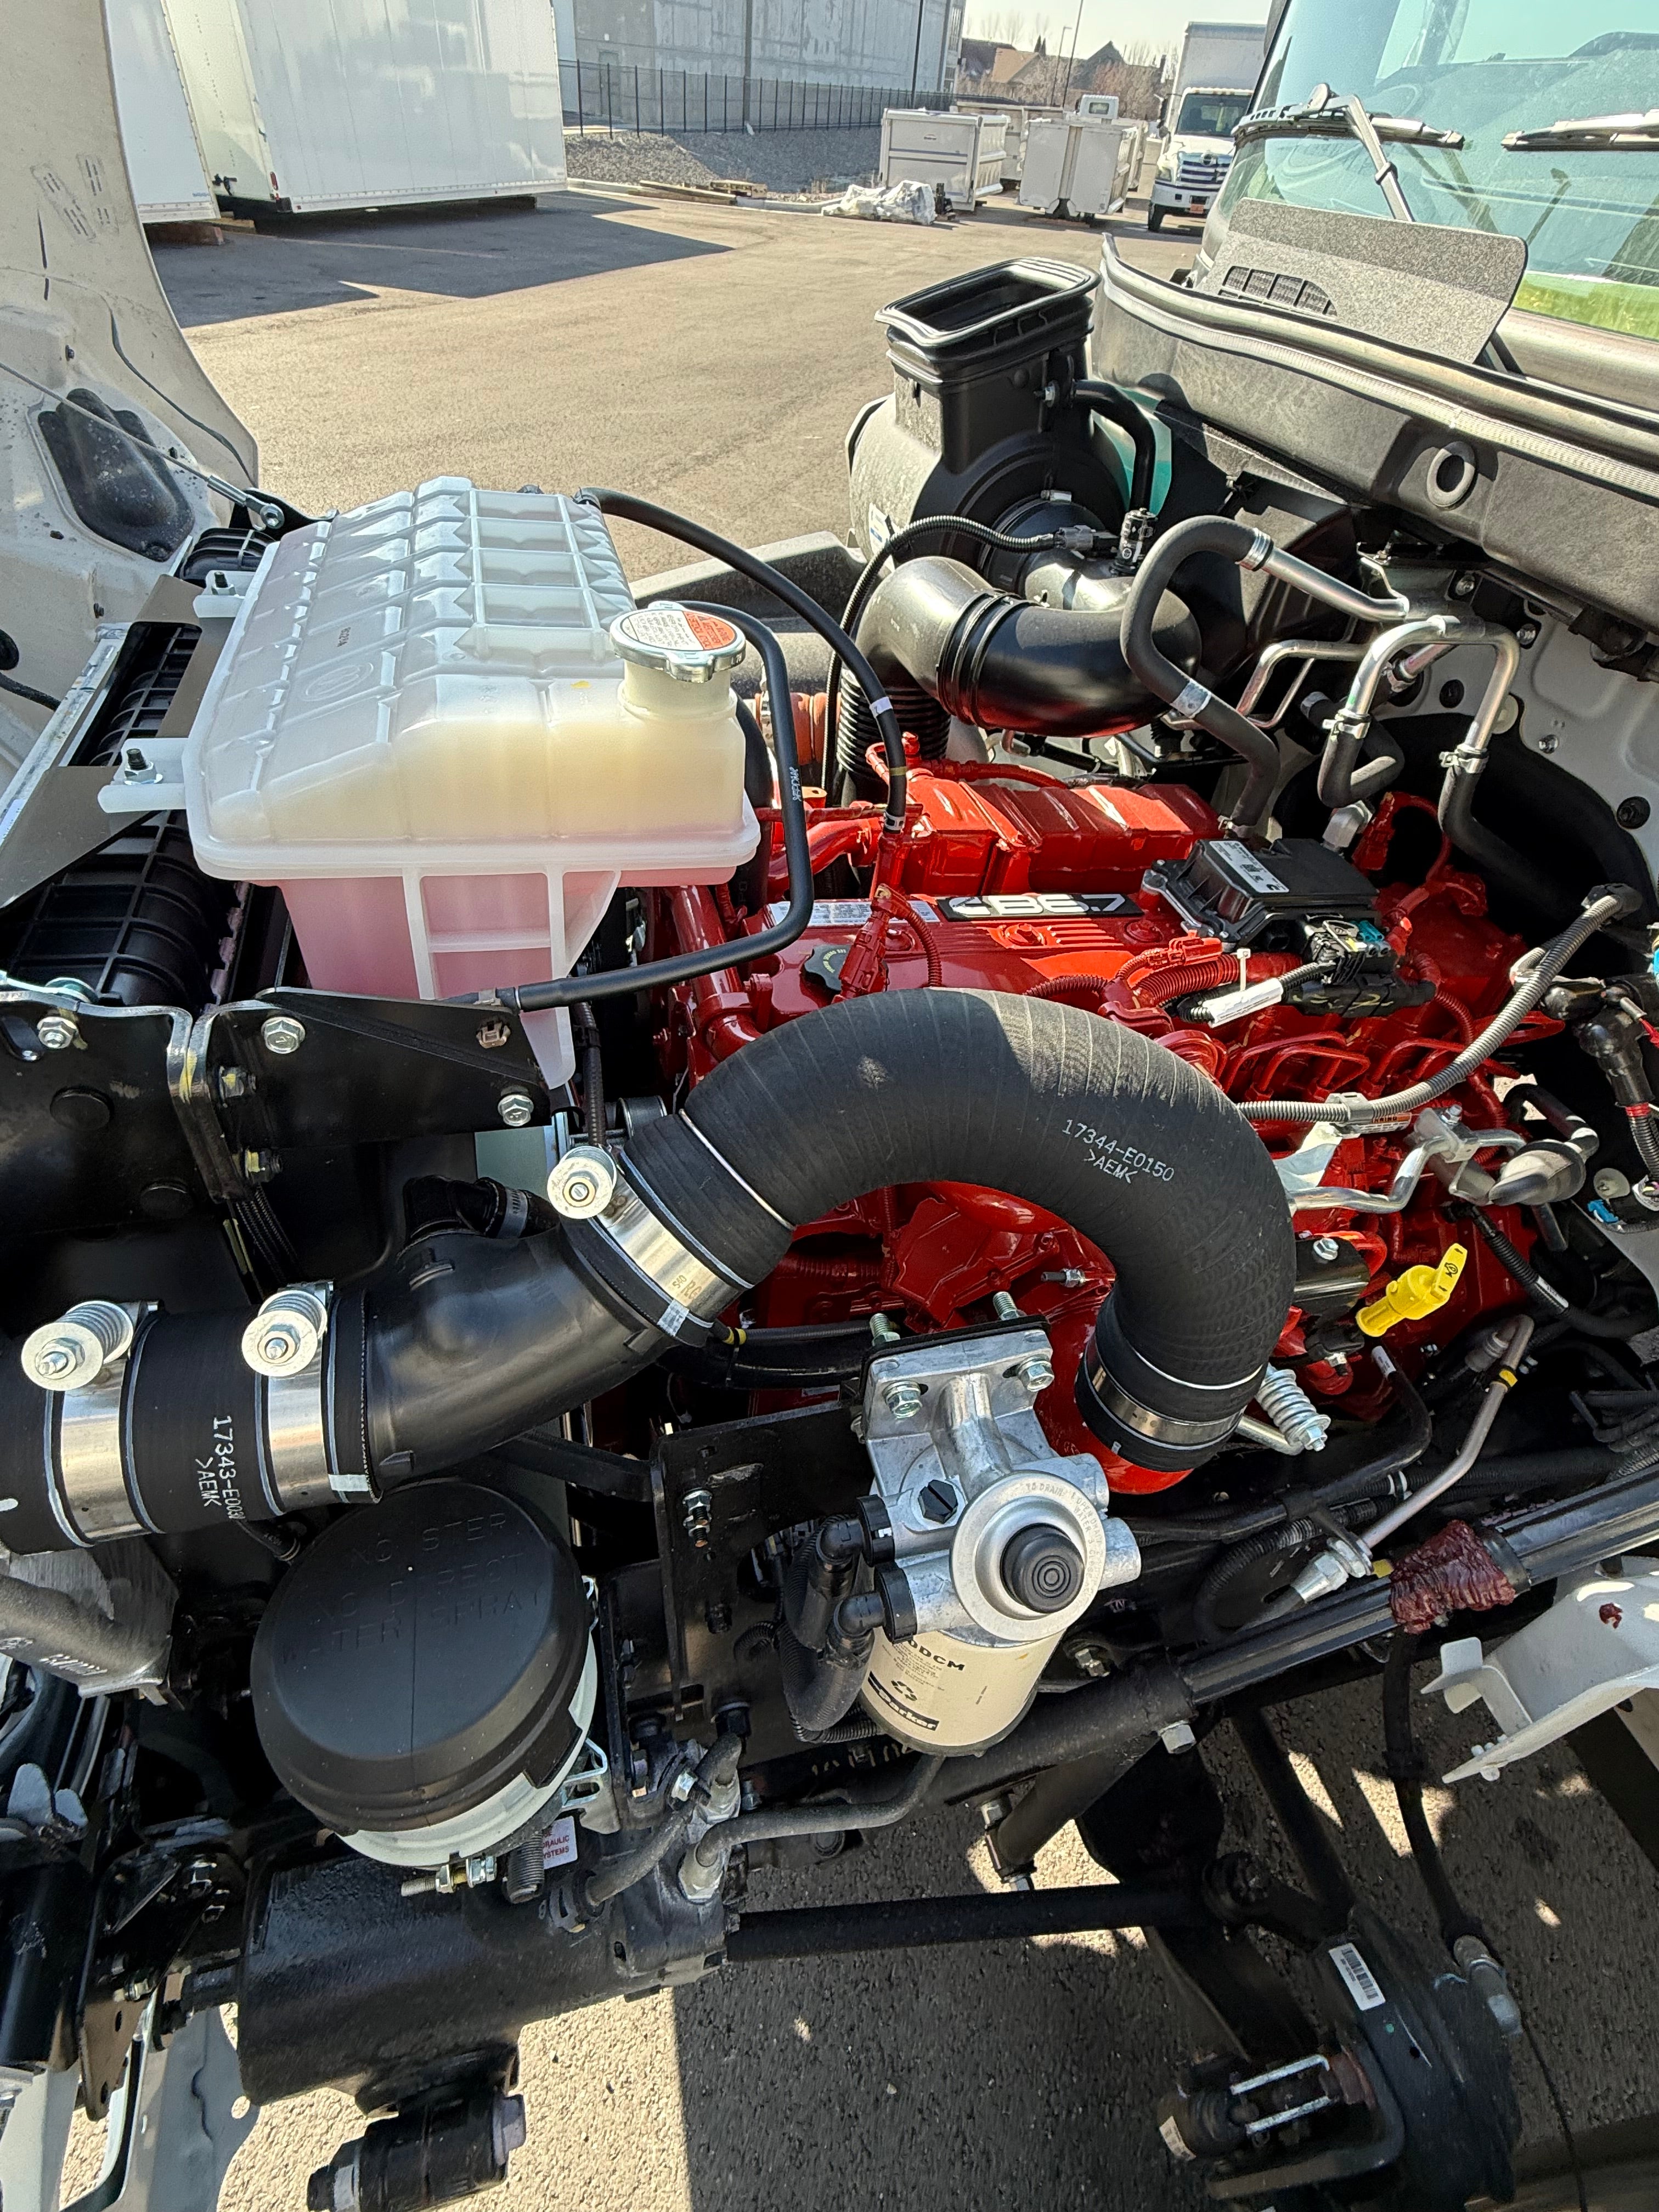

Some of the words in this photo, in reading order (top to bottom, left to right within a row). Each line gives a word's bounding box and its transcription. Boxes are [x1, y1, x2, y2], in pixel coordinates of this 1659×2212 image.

[988, 894, 1126, 916] B6.7
[1062, 1119, 1175, 1182] 17344-E0150
[1084, 1148, 1138, 1184] >AEM<
[1073, 1506, 1092, 1532] WATER
[1076, 1497, 1093, 1519] OPEN
[422, 1513, 507, 1553] STEP
[543, 1835, 569, 1848] RAULIC
[544, 1846, 569, 1859] YSTEMS
